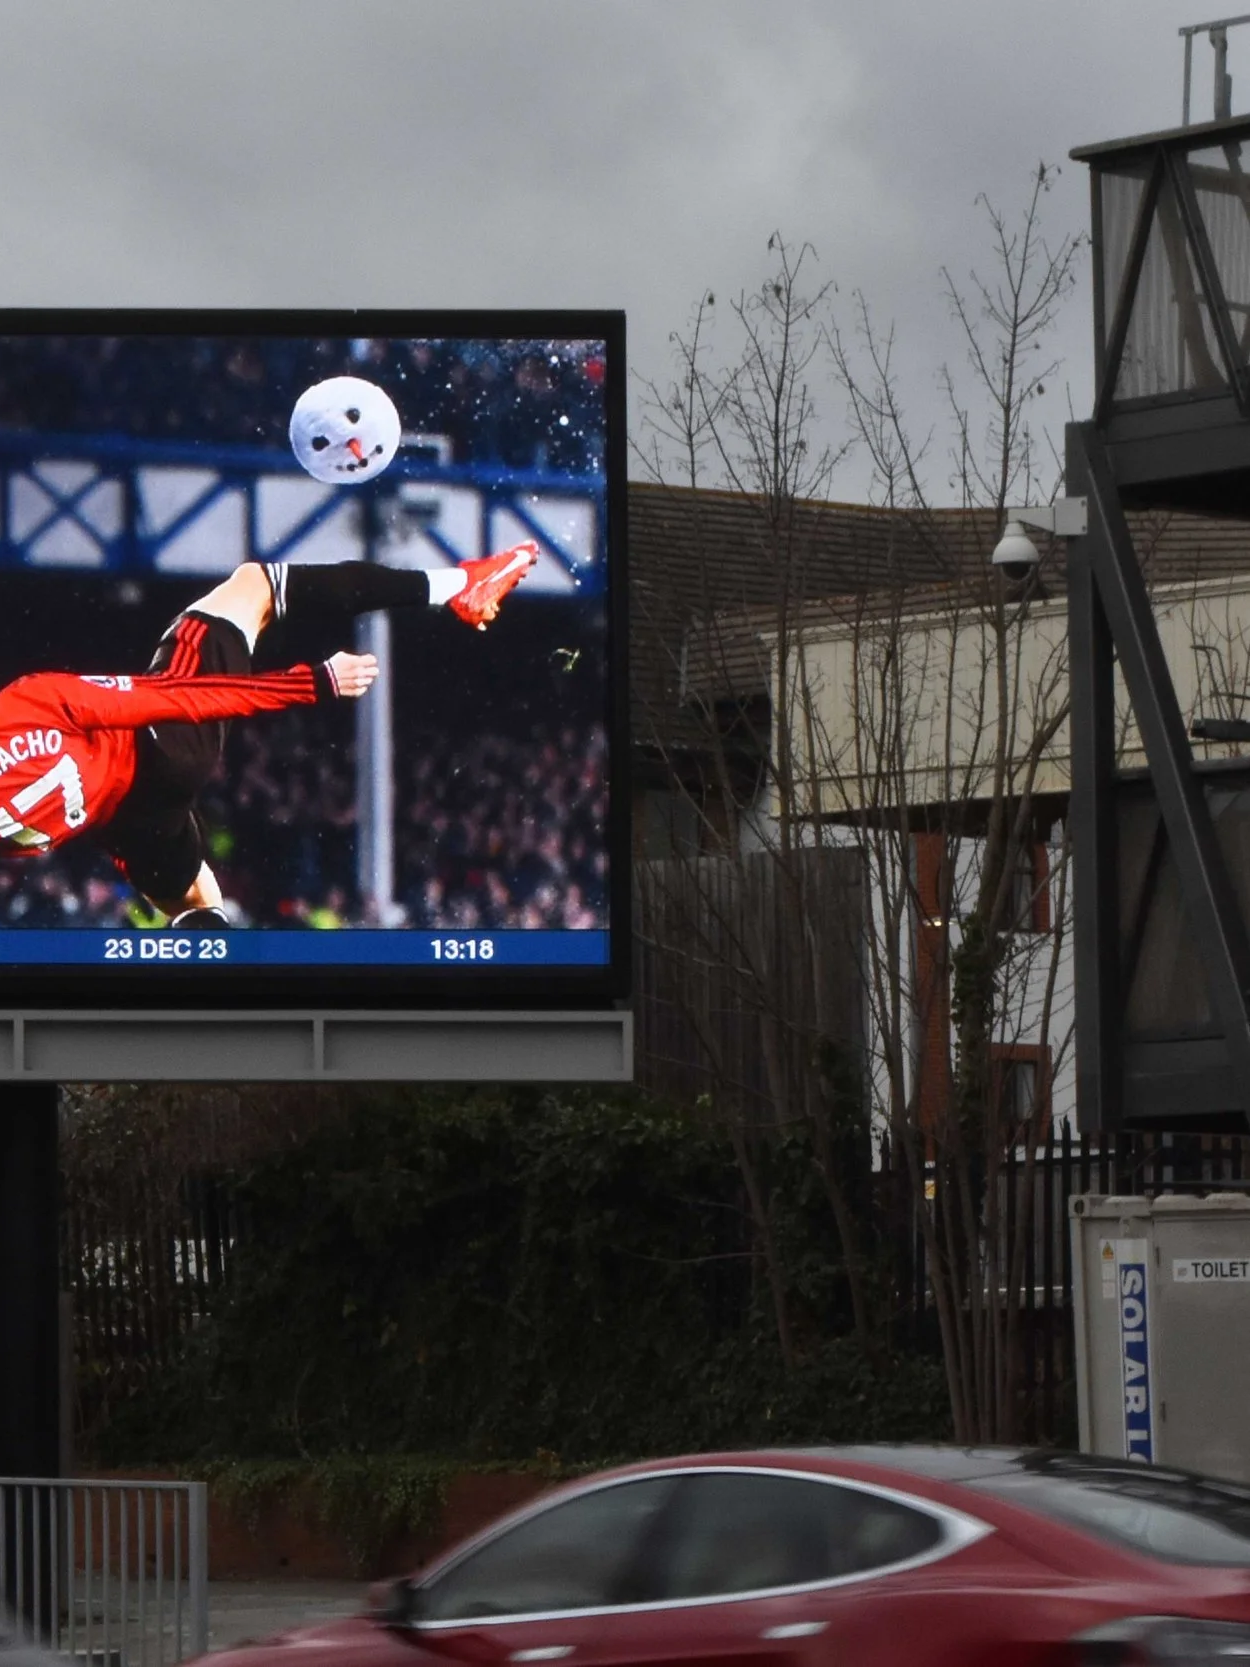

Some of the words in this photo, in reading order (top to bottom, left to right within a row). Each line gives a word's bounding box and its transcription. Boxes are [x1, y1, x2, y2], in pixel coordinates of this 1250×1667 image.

[104, 938, 133, 959] 23
[140, 938, 191, 959] DEC
[198, 938, 228, 959] 23
[430, 939, 494, 960] 13:18
[1191, 1261, 1249, 1279] TOILET
[1121, 1269, 1148, 1415] SOLAR
